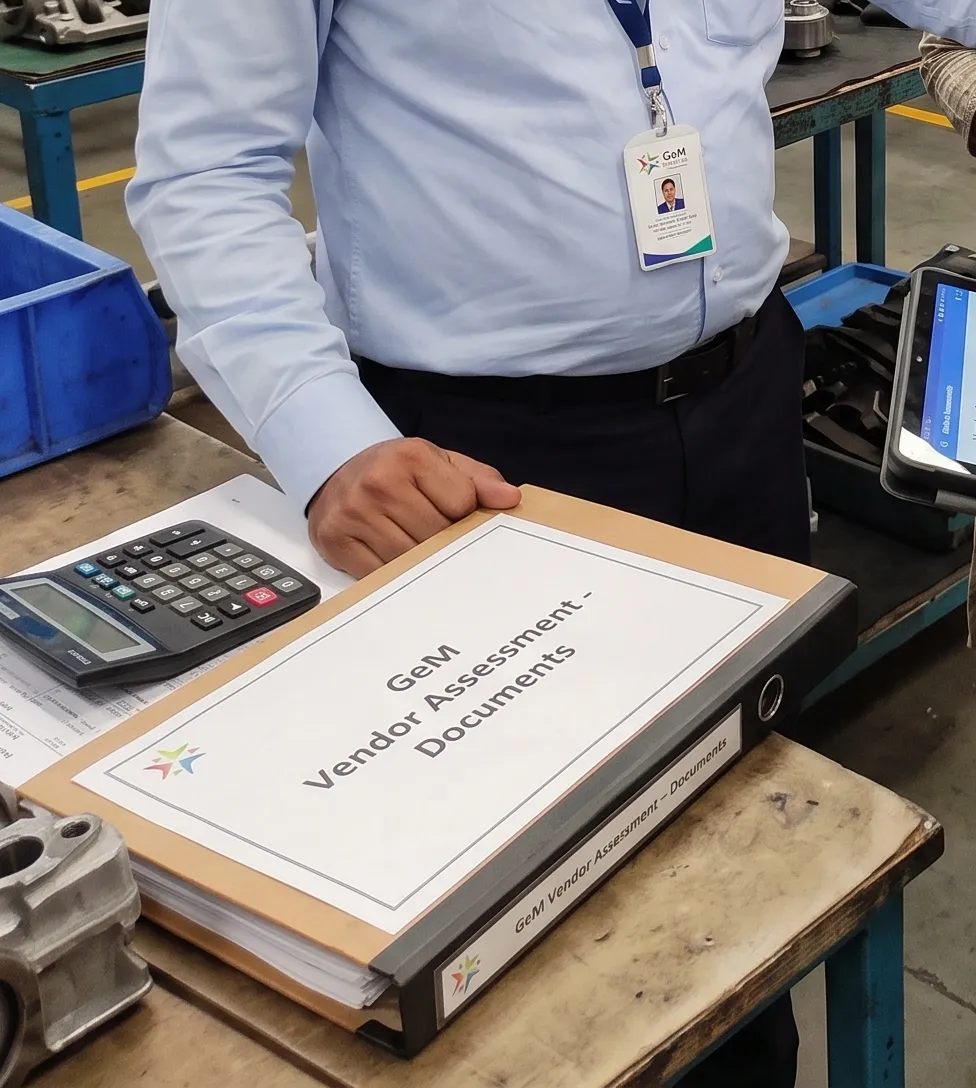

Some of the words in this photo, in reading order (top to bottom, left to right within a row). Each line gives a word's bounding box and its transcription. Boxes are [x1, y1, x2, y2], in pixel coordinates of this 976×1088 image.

[302, 711, 422, 789] Vendor
[423, 599, 583, 713] Assessment
[387, 644, 461, 692] GeM
[413, 645, 576, 758] Documents
[515, 899, 545, 934] GeM
[548, 860, 592, 904] Vendor
[670, 737, 727, 796] Documents
